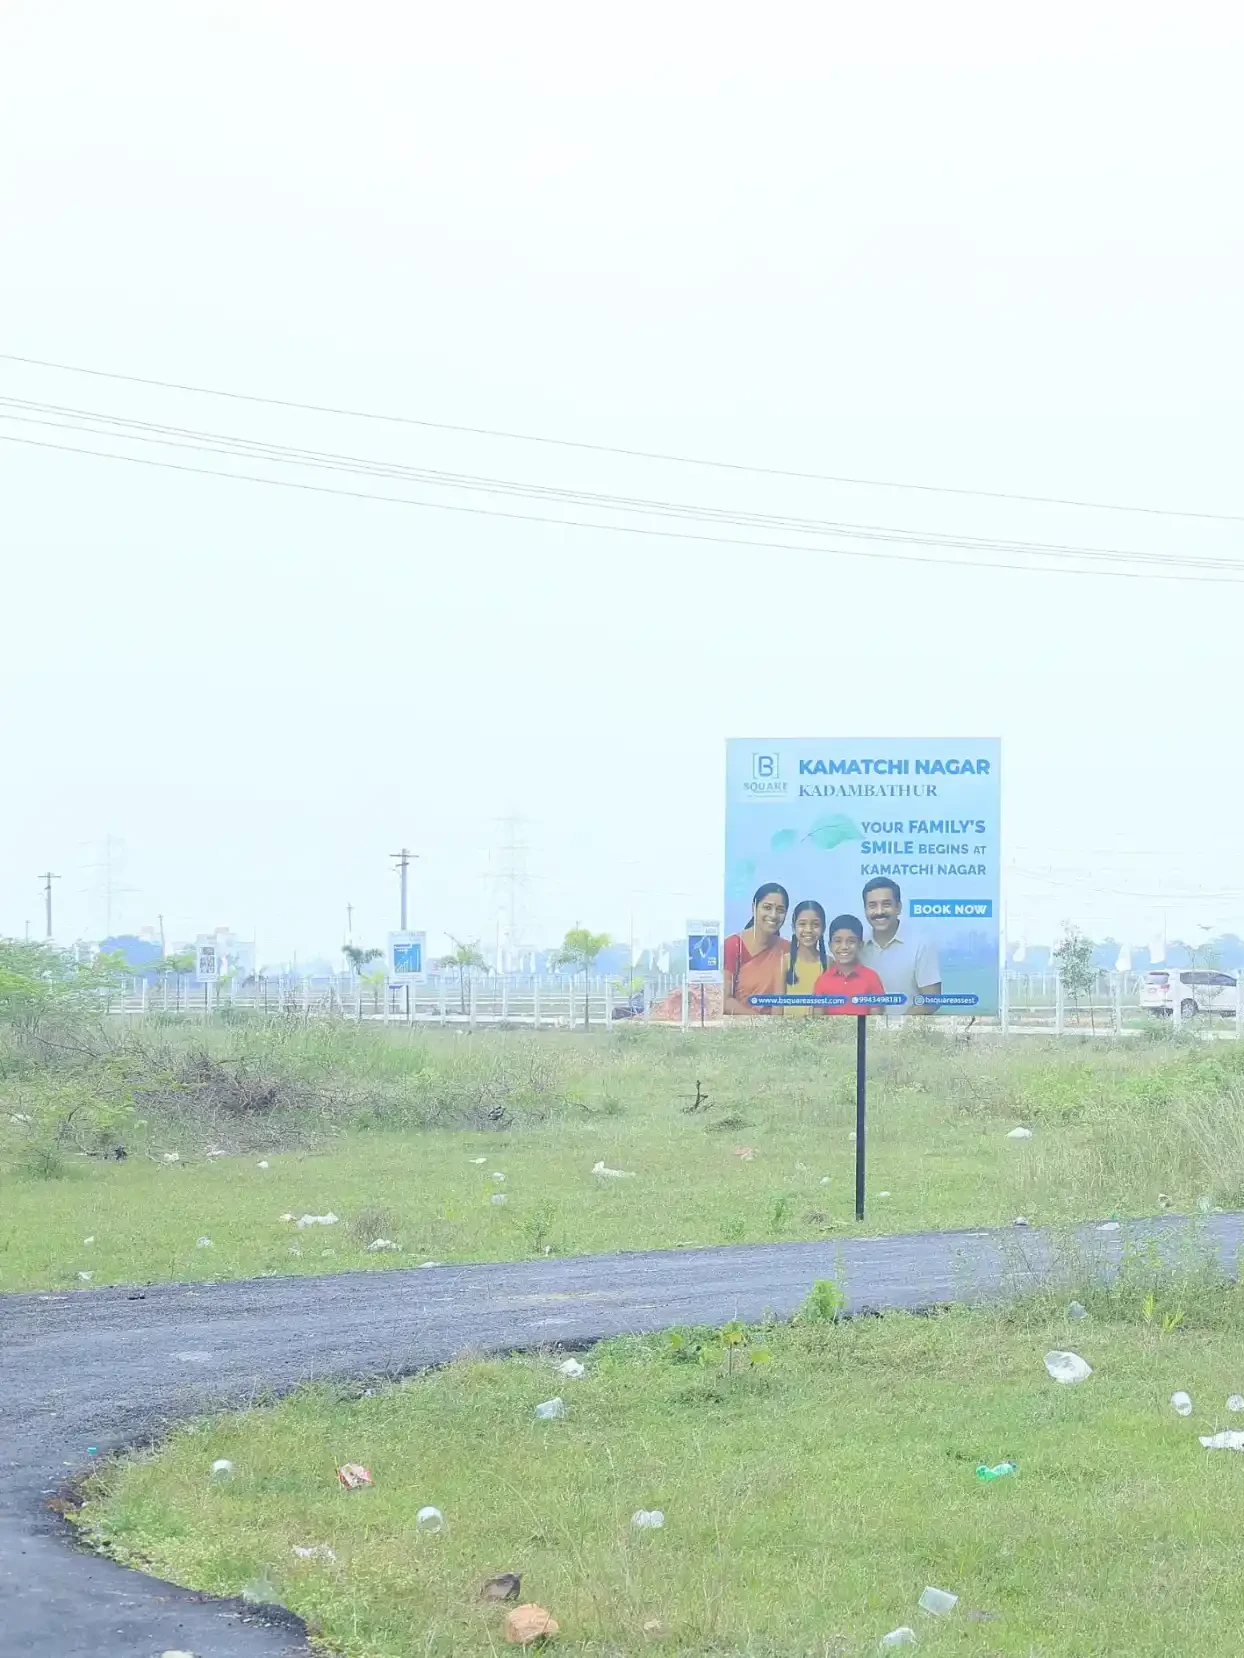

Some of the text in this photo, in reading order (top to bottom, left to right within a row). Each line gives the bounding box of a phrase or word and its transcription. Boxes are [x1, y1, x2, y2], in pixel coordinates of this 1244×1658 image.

[799, 759, 991, 775] KAMATCHI NAGAR
[743, 781, 789, 793] SQUARE
[798, 784, 938, 797] KADAMBATHUR
[861, 819, 987, 834] YOUR FAMILY'S
[860, 840, 987, 854] SMILE BEGINS AT
[860, 864, 987, 876] KAMATCHI NAGAR
[913, 904, 988, 915] BOOK NOW
